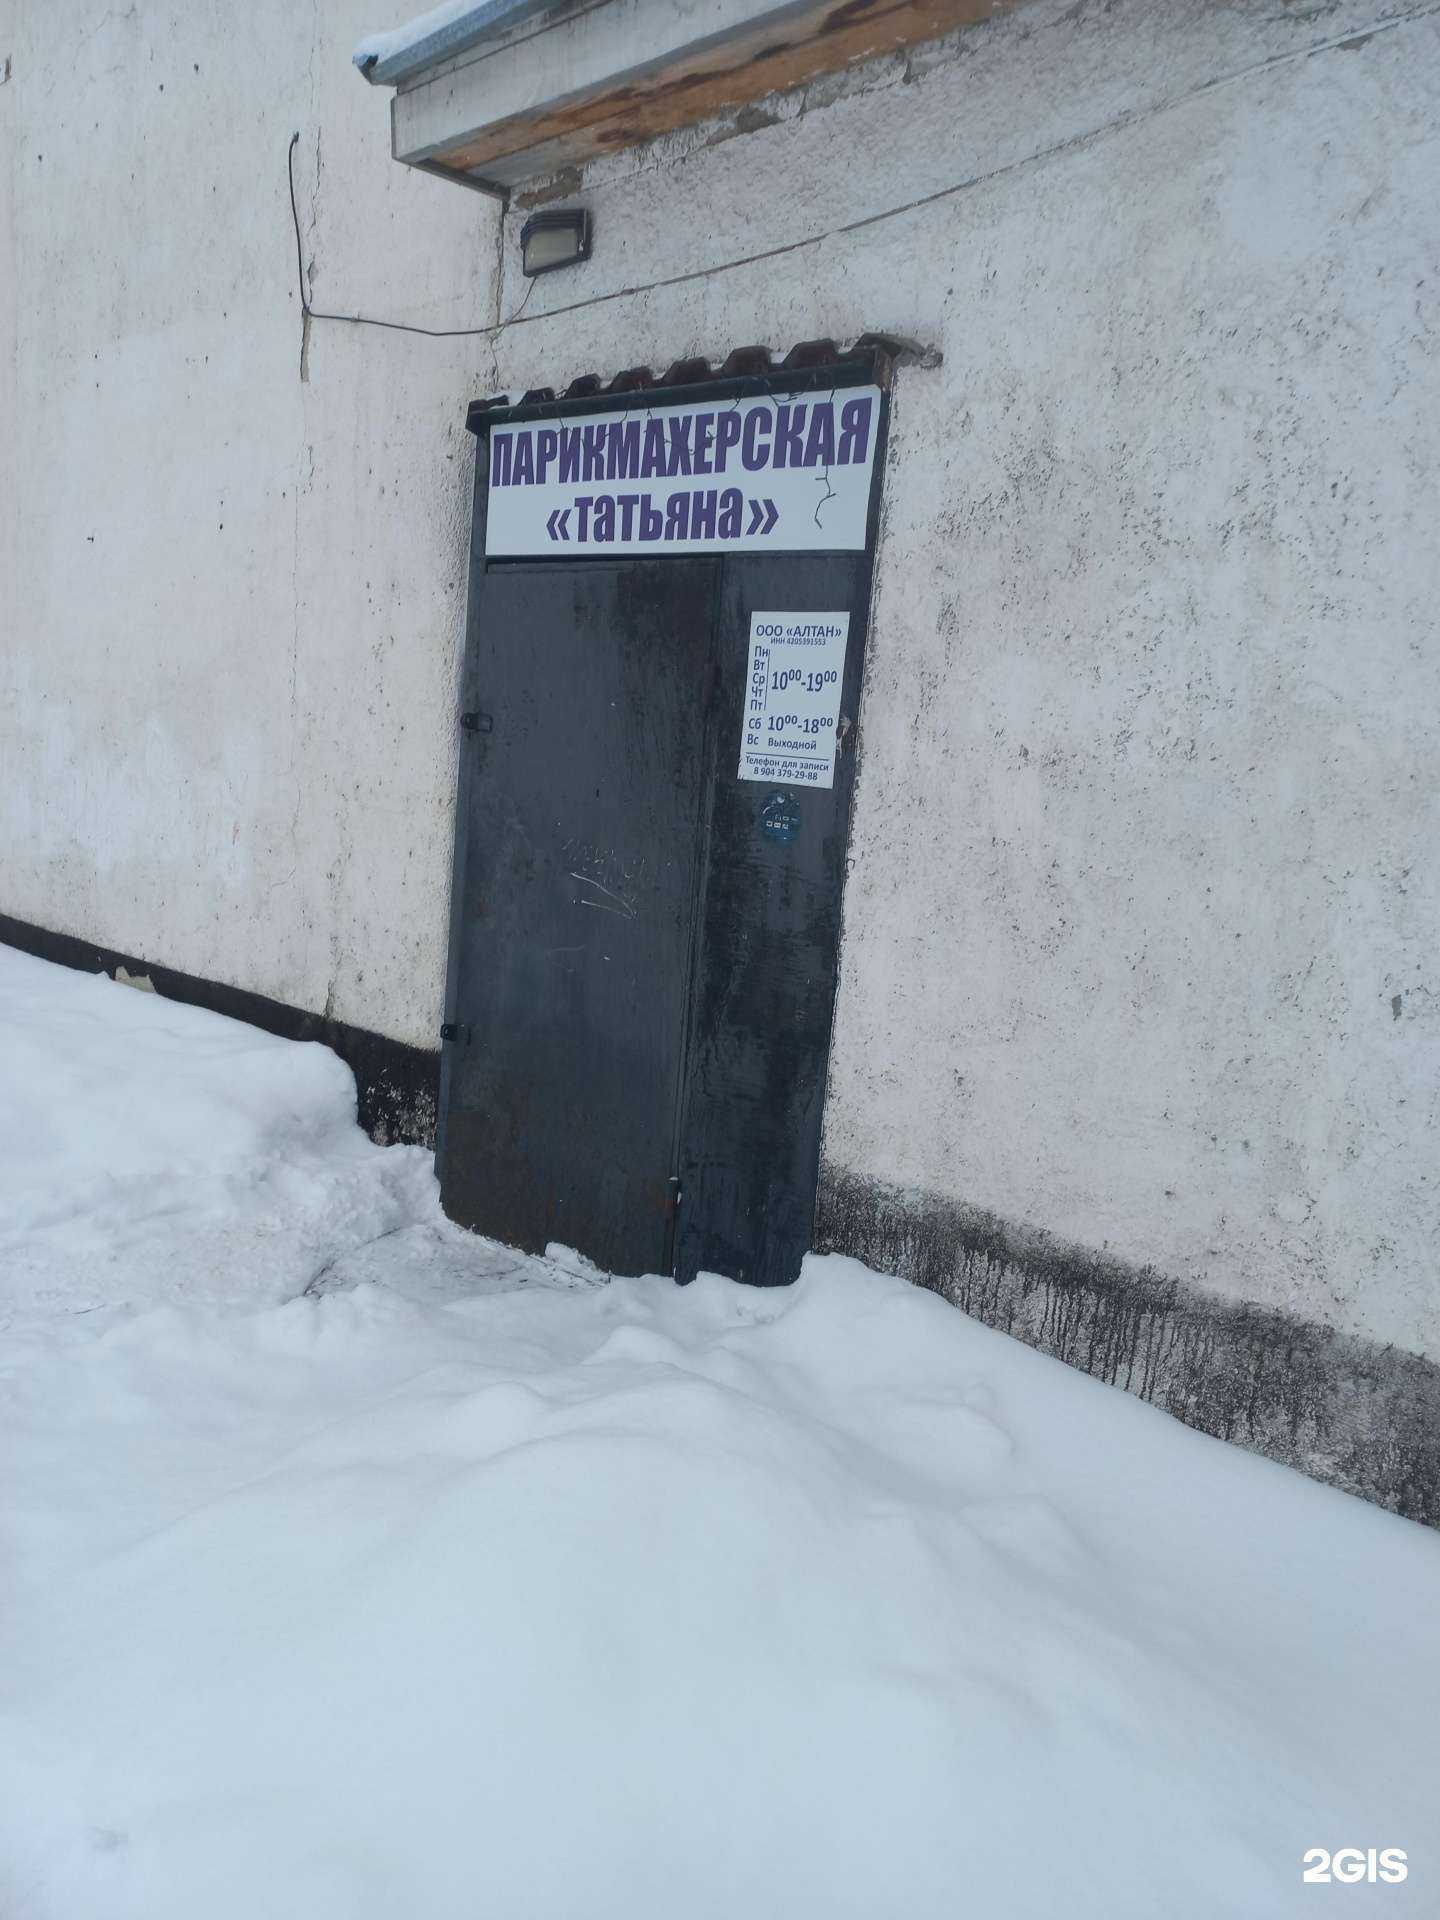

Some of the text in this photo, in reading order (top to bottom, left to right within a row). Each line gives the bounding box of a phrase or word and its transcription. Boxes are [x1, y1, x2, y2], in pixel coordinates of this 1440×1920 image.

[491, 396, 873, 487] ПАРИКМАХЕРСКАЯ
[756, 624, 842, 638] ООО «АЛТАН»
[770, 637, 785, 645] ИНН
[754, 646, 768, 657] Пн
[753, 660, 765, 670] Вт
[752, 673, 765, 685] Ср
[751, 686, 763, 697] Чт
[750, 700, 763, 711] Пт
[748, 718, 762, 729] Сб
[747, 734, 817, 750] Вс Выходной
[745, 756, 829, 771] Телефон для записи
[753, 767, 818, 781] 8 904 379-29-88
